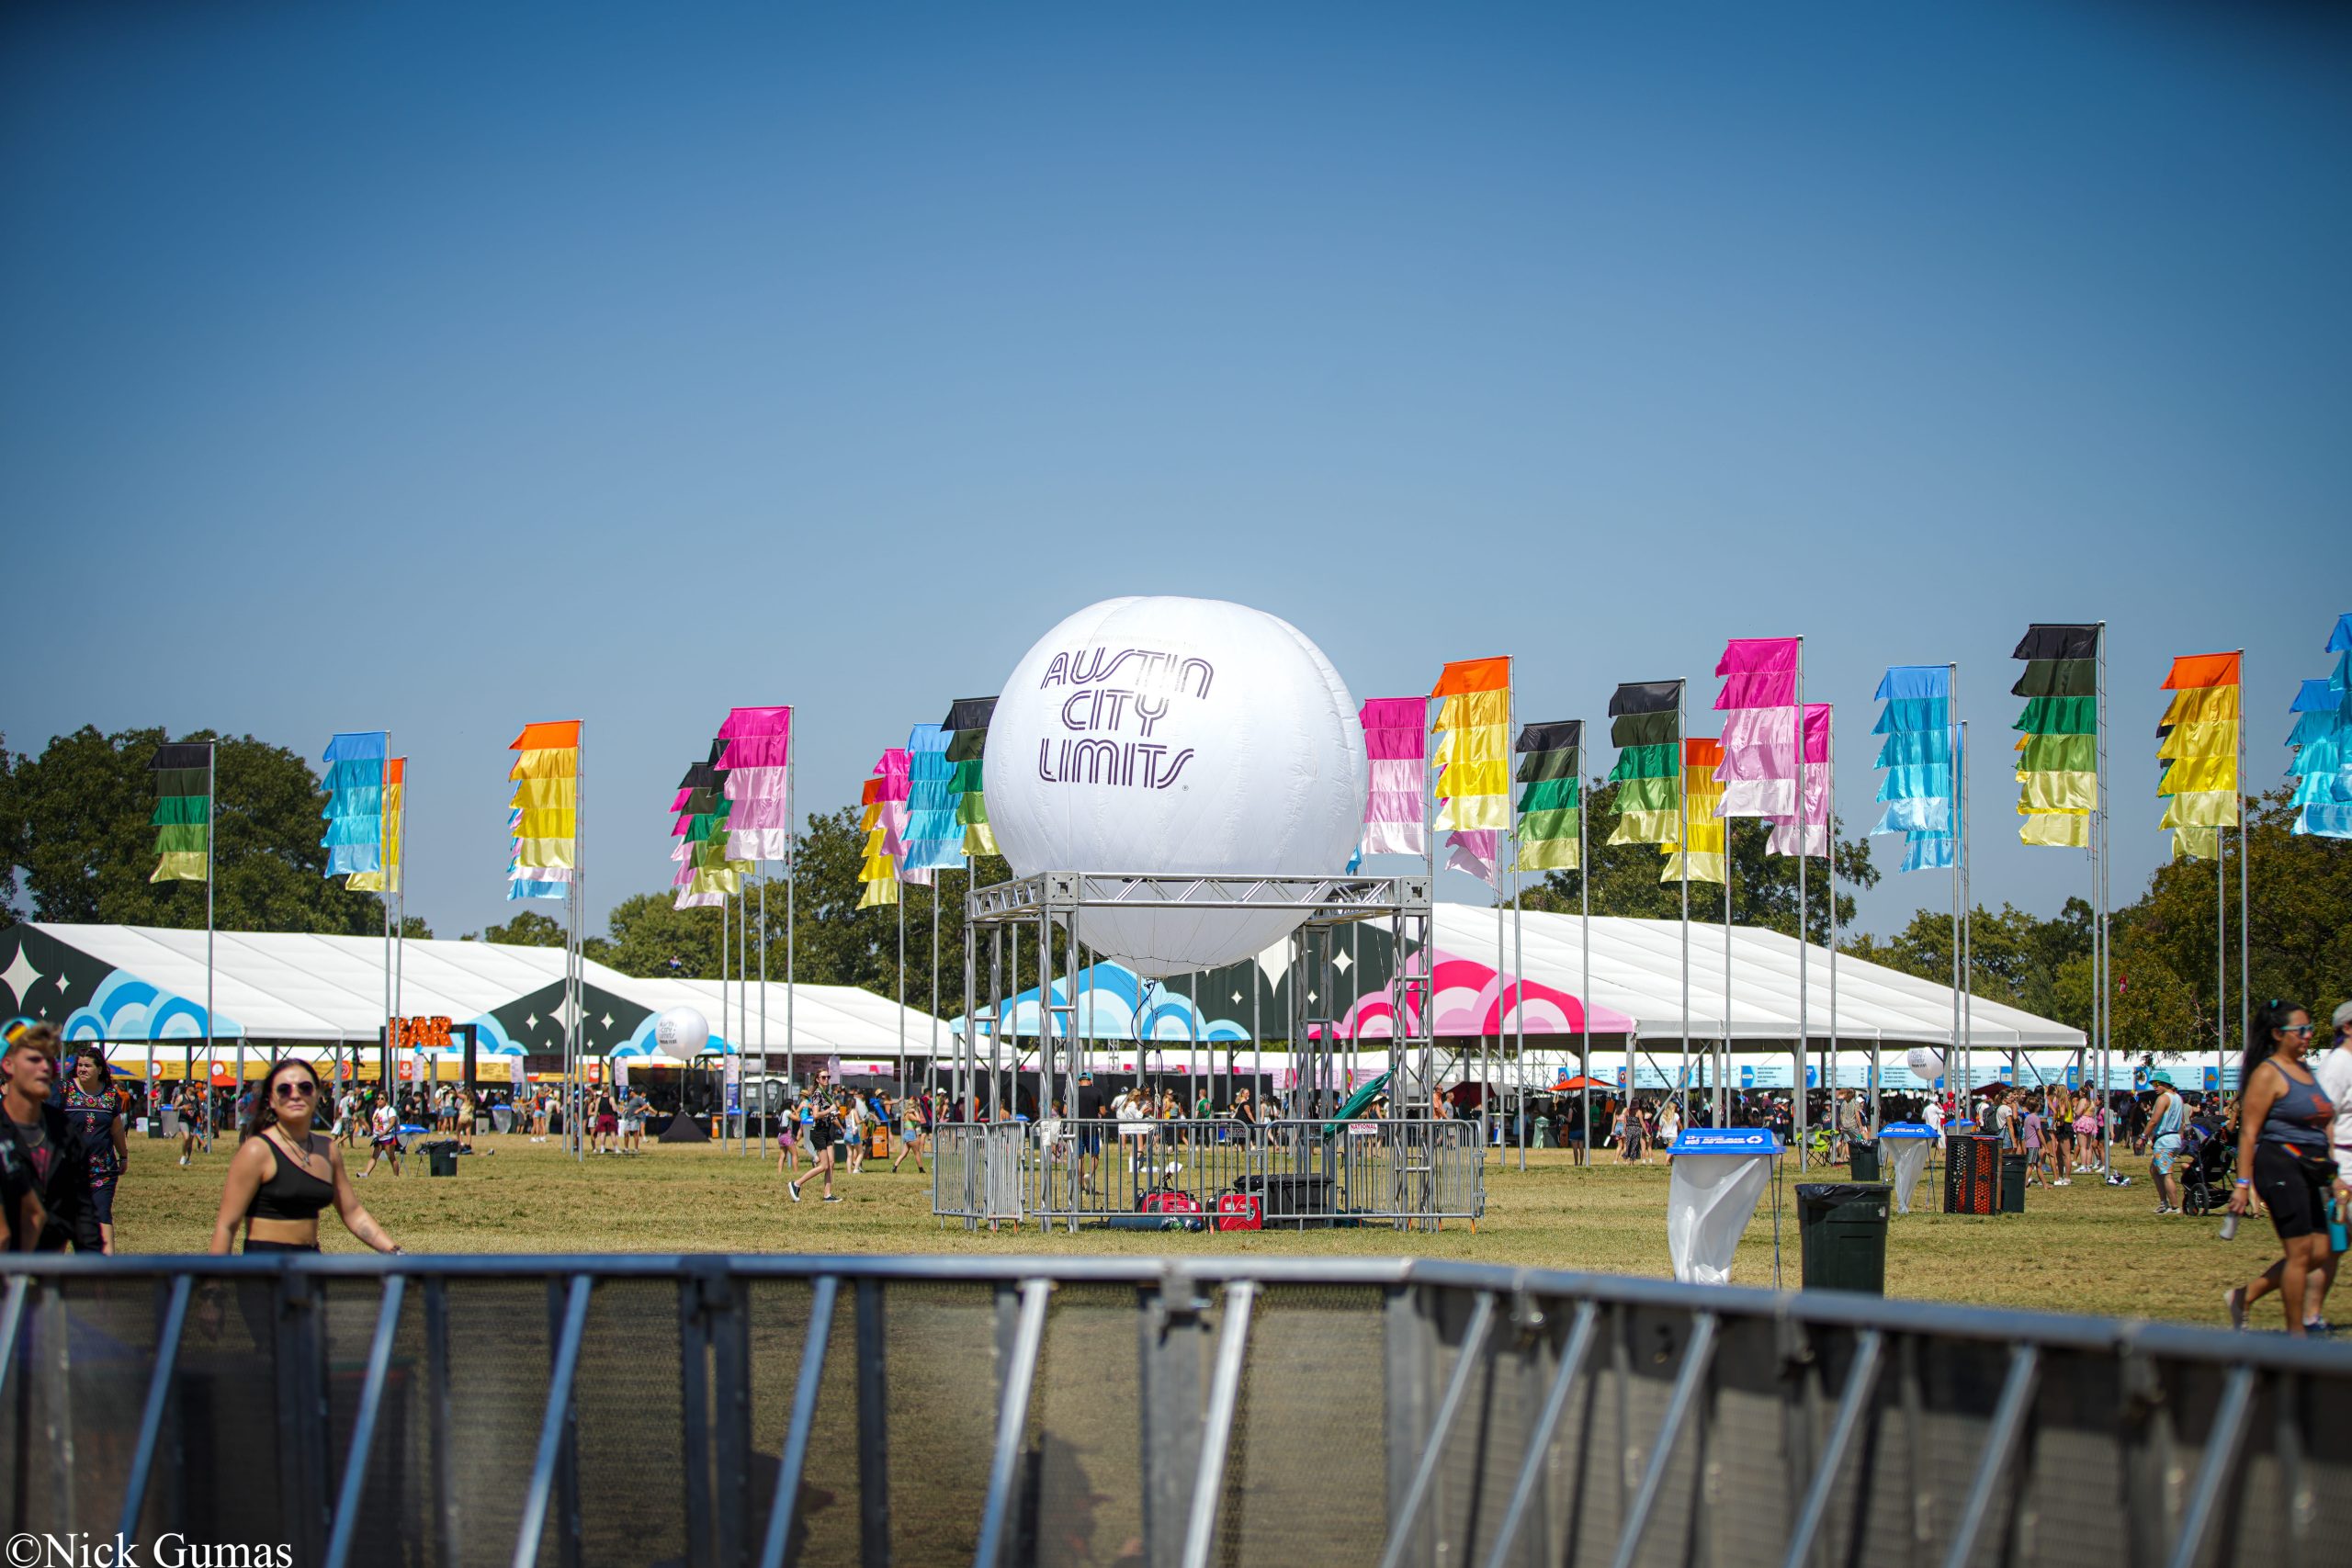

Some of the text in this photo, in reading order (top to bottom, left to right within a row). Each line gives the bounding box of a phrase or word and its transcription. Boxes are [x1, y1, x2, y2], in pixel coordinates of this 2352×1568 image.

[1040, 647, 1215, 700] AUSTIN
[1061, 689, 1170, 738] CITY
[1039, 738, 1194, 790] LIMITS
[390, 1016, 454, 1048] BAR
